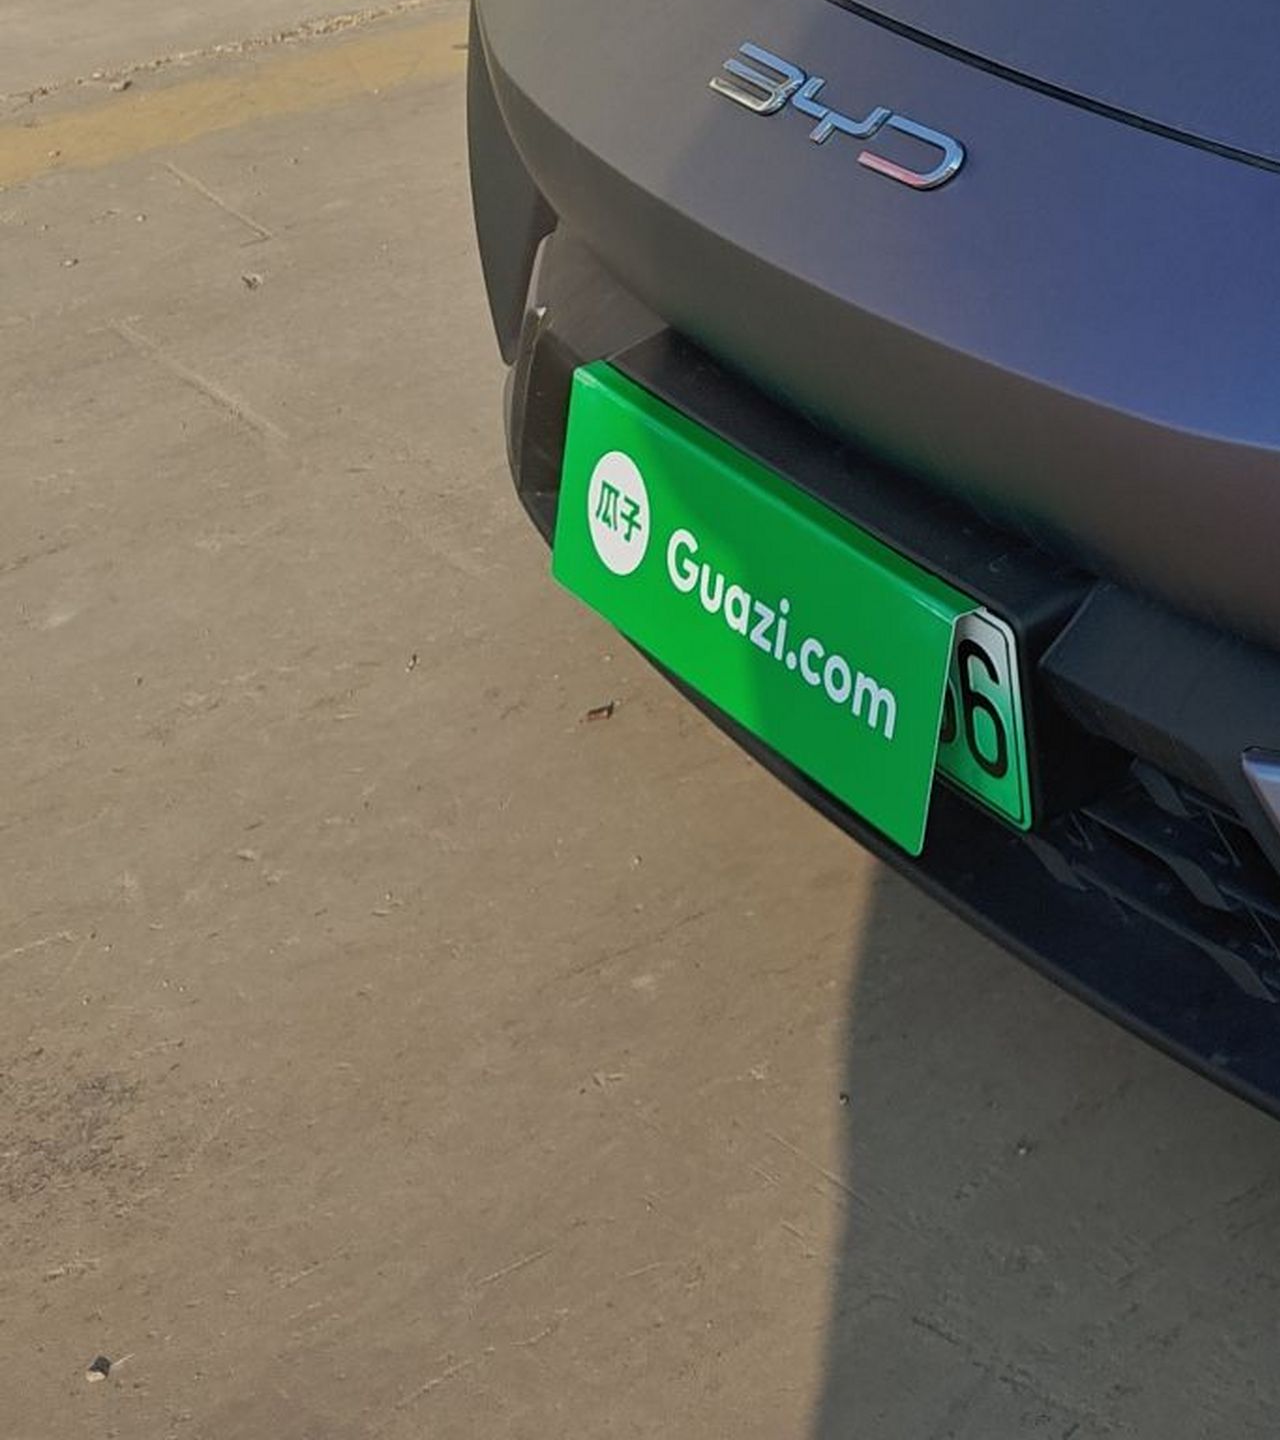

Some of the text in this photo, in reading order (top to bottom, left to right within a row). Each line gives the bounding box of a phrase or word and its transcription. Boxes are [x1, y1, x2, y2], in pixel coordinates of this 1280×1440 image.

[709, 42, 965, 192] BYD
[596, 480, 642, 543] 瓜子
[667, 528, 897, 740] Guazi.com
